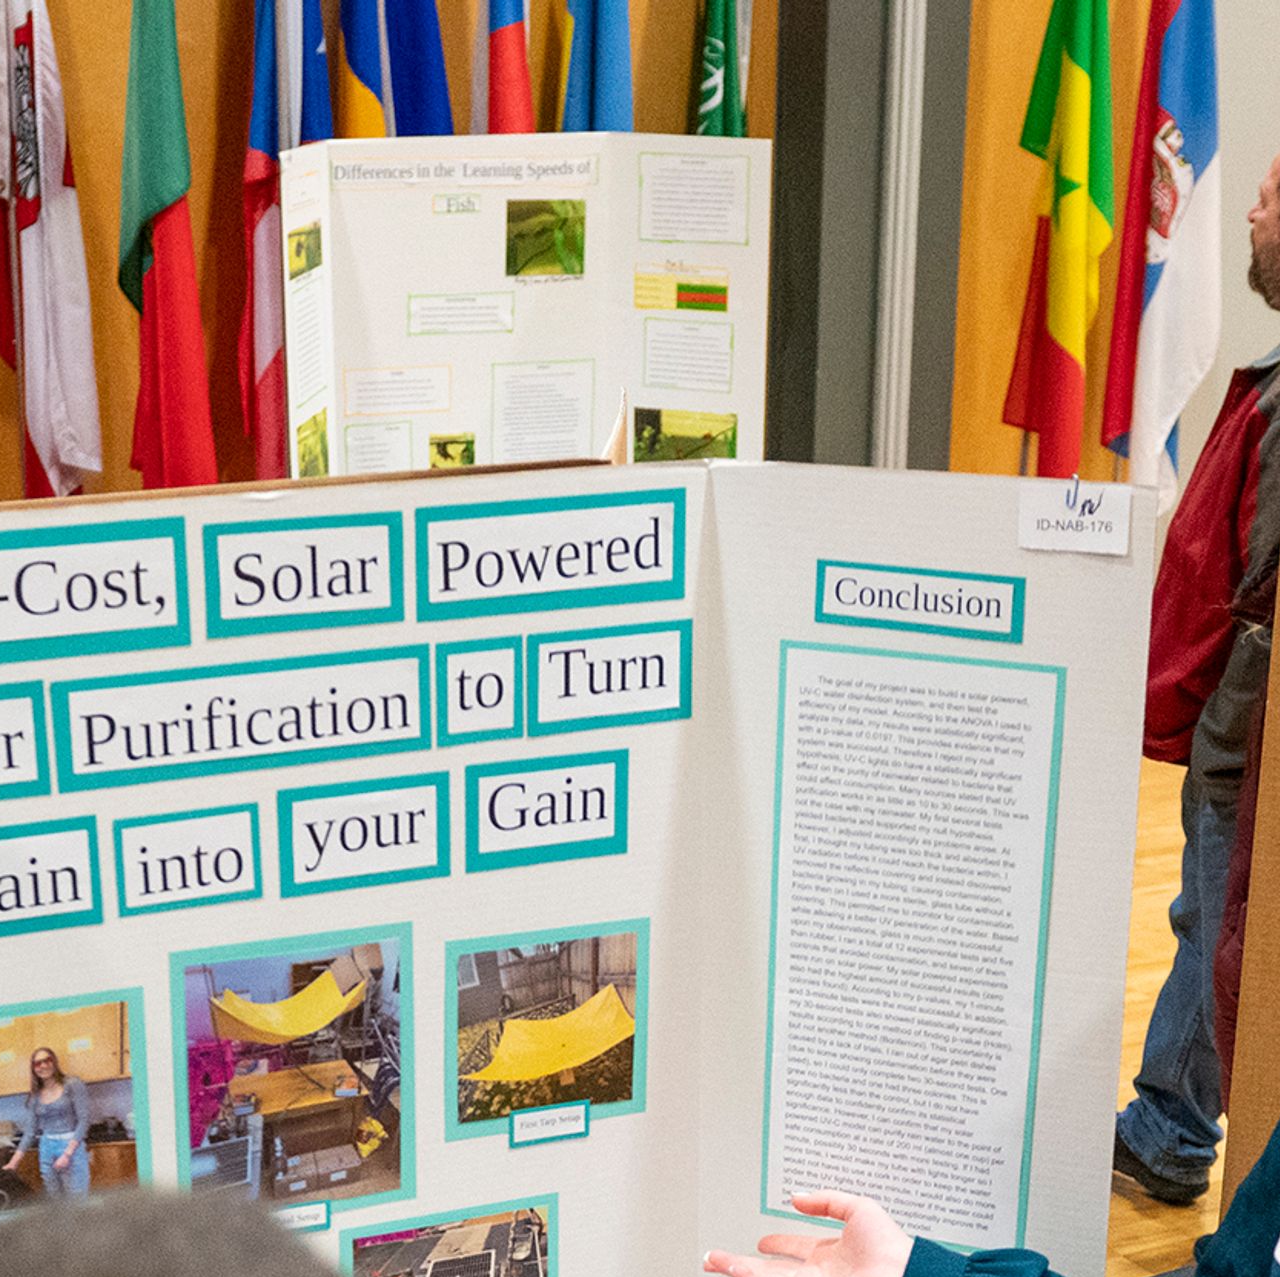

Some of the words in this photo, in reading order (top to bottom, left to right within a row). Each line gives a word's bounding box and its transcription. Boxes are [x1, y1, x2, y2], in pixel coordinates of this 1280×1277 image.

[334, 163, 414, 181] Differences
[417, 162, 430, 178] in
[433, 161, 455, 177] the
[462, 161, 523, 181] Learning
[526, 159, 574, 180] Speeds
[577, 158, 591, 174] of
[446, 196, 476, 213] Fish
[1036, 518, 1114, 535] ID-NAB-176
[233, 544, 379, 607] Solar
[437, 517, 663, 593] Powered
[834, 577, 1003, 619] Conclusion
[80, 687, 411, 767] Purification
[456, 669, 504, 710] to
[549, 648, 668, 700] Turn
[959, 714, 993, 726] ANOVA
[137, 843, 244, 896] into
[303, 806, 427, 871] your
[487, 777, 609, 832] Gain
